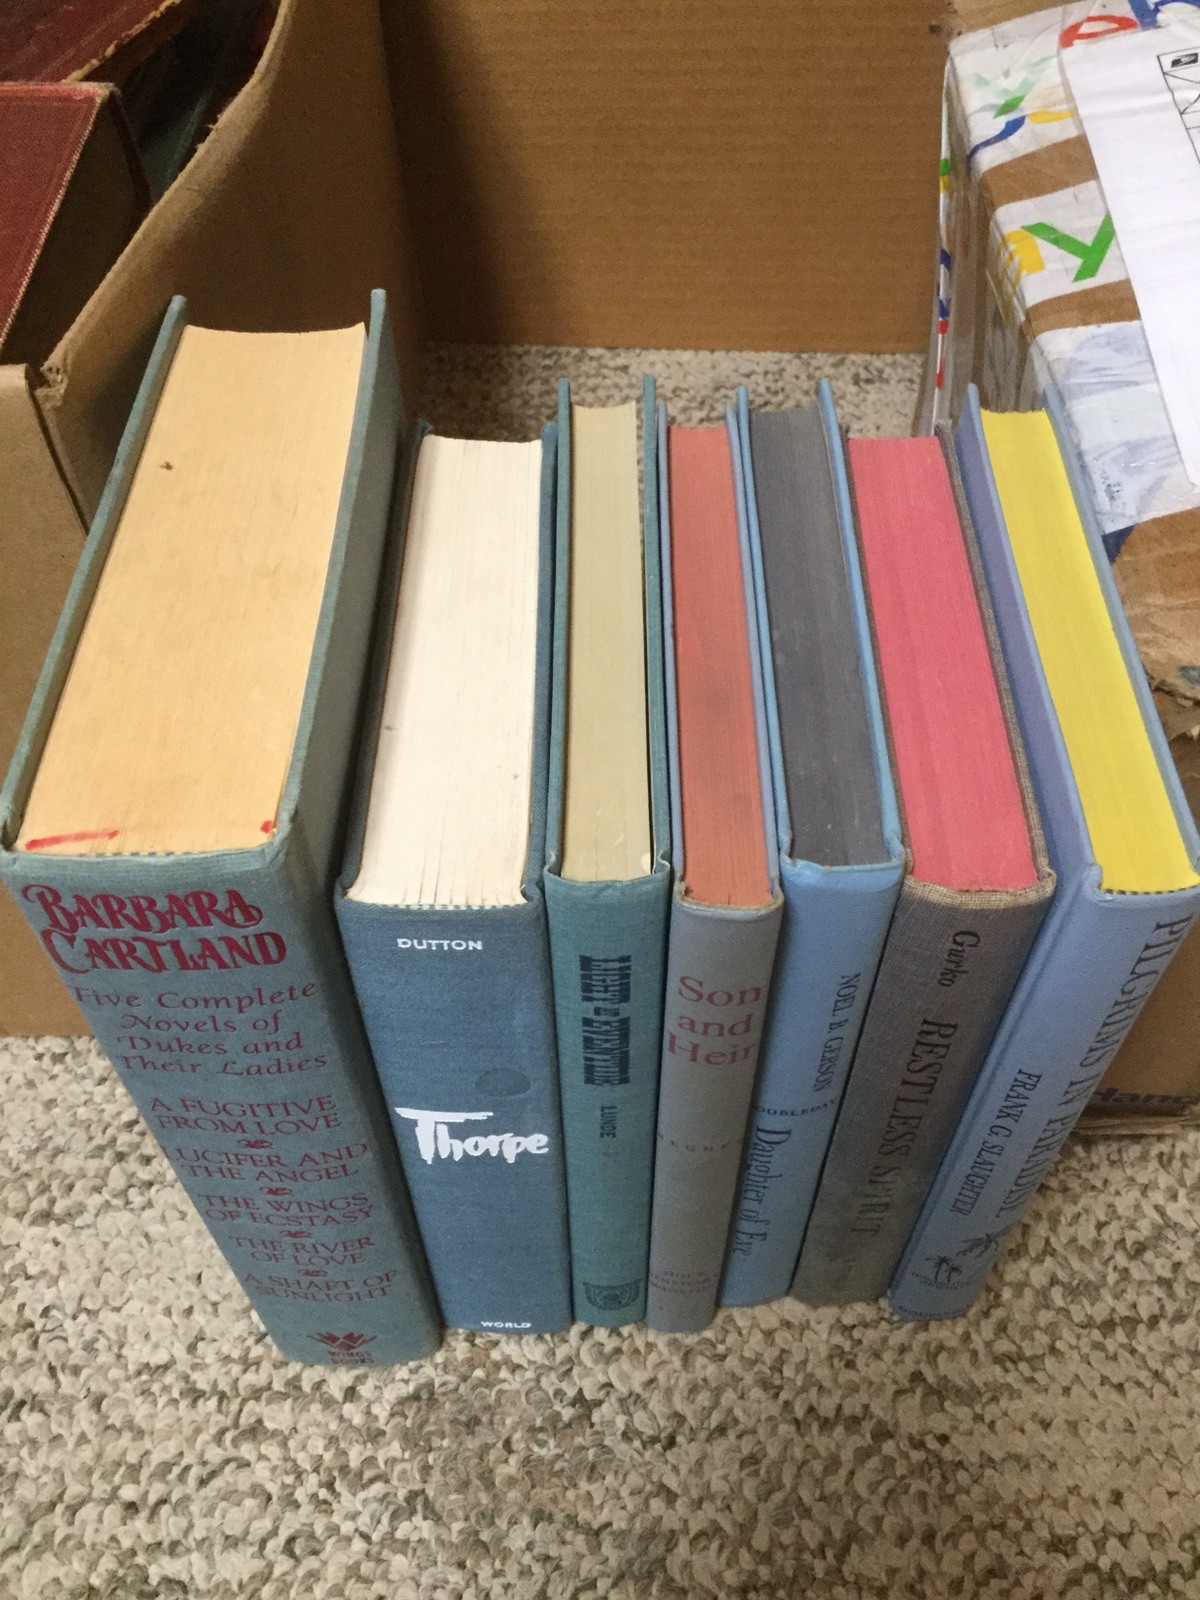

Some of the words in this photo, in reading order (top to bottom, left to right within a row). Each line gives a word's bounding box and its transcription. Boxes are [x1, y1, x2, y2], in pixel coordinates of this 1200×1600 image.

[21, 884, 264, 934] BARBARA
[41, 929, 287, 974] CARTLAND
[397, 938, 483, 950] DUTTON
[937, 930, 981, 988] Gurko
[68, 984, 141, 1008] Five
[157, 980, 318, 1014] Complete
[678, 976, 763, 1007] Son
[832, 972, 861, 1017] NOEL
[120, 1013, 238, 1034] Novels
[252, 1010, 283, 1034] of
[677, 1013, 753, 1038] and
[117, 1034, 229, 1056] Dukes
[242, 1032, 304, 1052] and
[667, 1032, 758, 1066] Heir
[115, 1054, 202, 1074] Their
[217, 1054, 328, 1076] Ladies
[813, 1037, 844, 1093] GERSON
[150, 1097, 173, 1112] A
[179, 1095, 338, 1118] FUGITIVE
[996, 1068, 1043, 1123] FRANK
[156, 1114, 248, 1134] FROM
[256, 1113, 343, 1135] LOVE
[600, 1105, 617, 1138] LUNDE
[394, 1107, 549, 1164] Thorpe
[162, 1146, 287, 1167] LUCIFER
[299, 1143, 368, 1165] AND
[744, 1124, 792, 1205] Daughter
[185, 1165, 246, 1181] THE
[256, 1164, 359, 1183] ANGEL
[951, 1140, 1005, 1216] SLAUGHTER
[200, 1194, 260, 1211] THE
[265, 1192, 371, 1214] WINGS
[205, 1208, 240, 1222] OF
[250, 1207, 374, 1227] ECSTASY
[740, 1208, 771, 1226] of
[229, 1236, 286, 1251] THE
[294, 1235, 377, 1254] RIVER
[250, 1251, 287, 1264] OF
[294, 1251, 367, 1267] LOVE
[270, 1276, 356, 1291] SHAFT
[363, 1270, 397, 1286] OF
[255, 1285, 391, 1302] SUNLIGHT
[481, 1321, 531, 1329] WORLD
